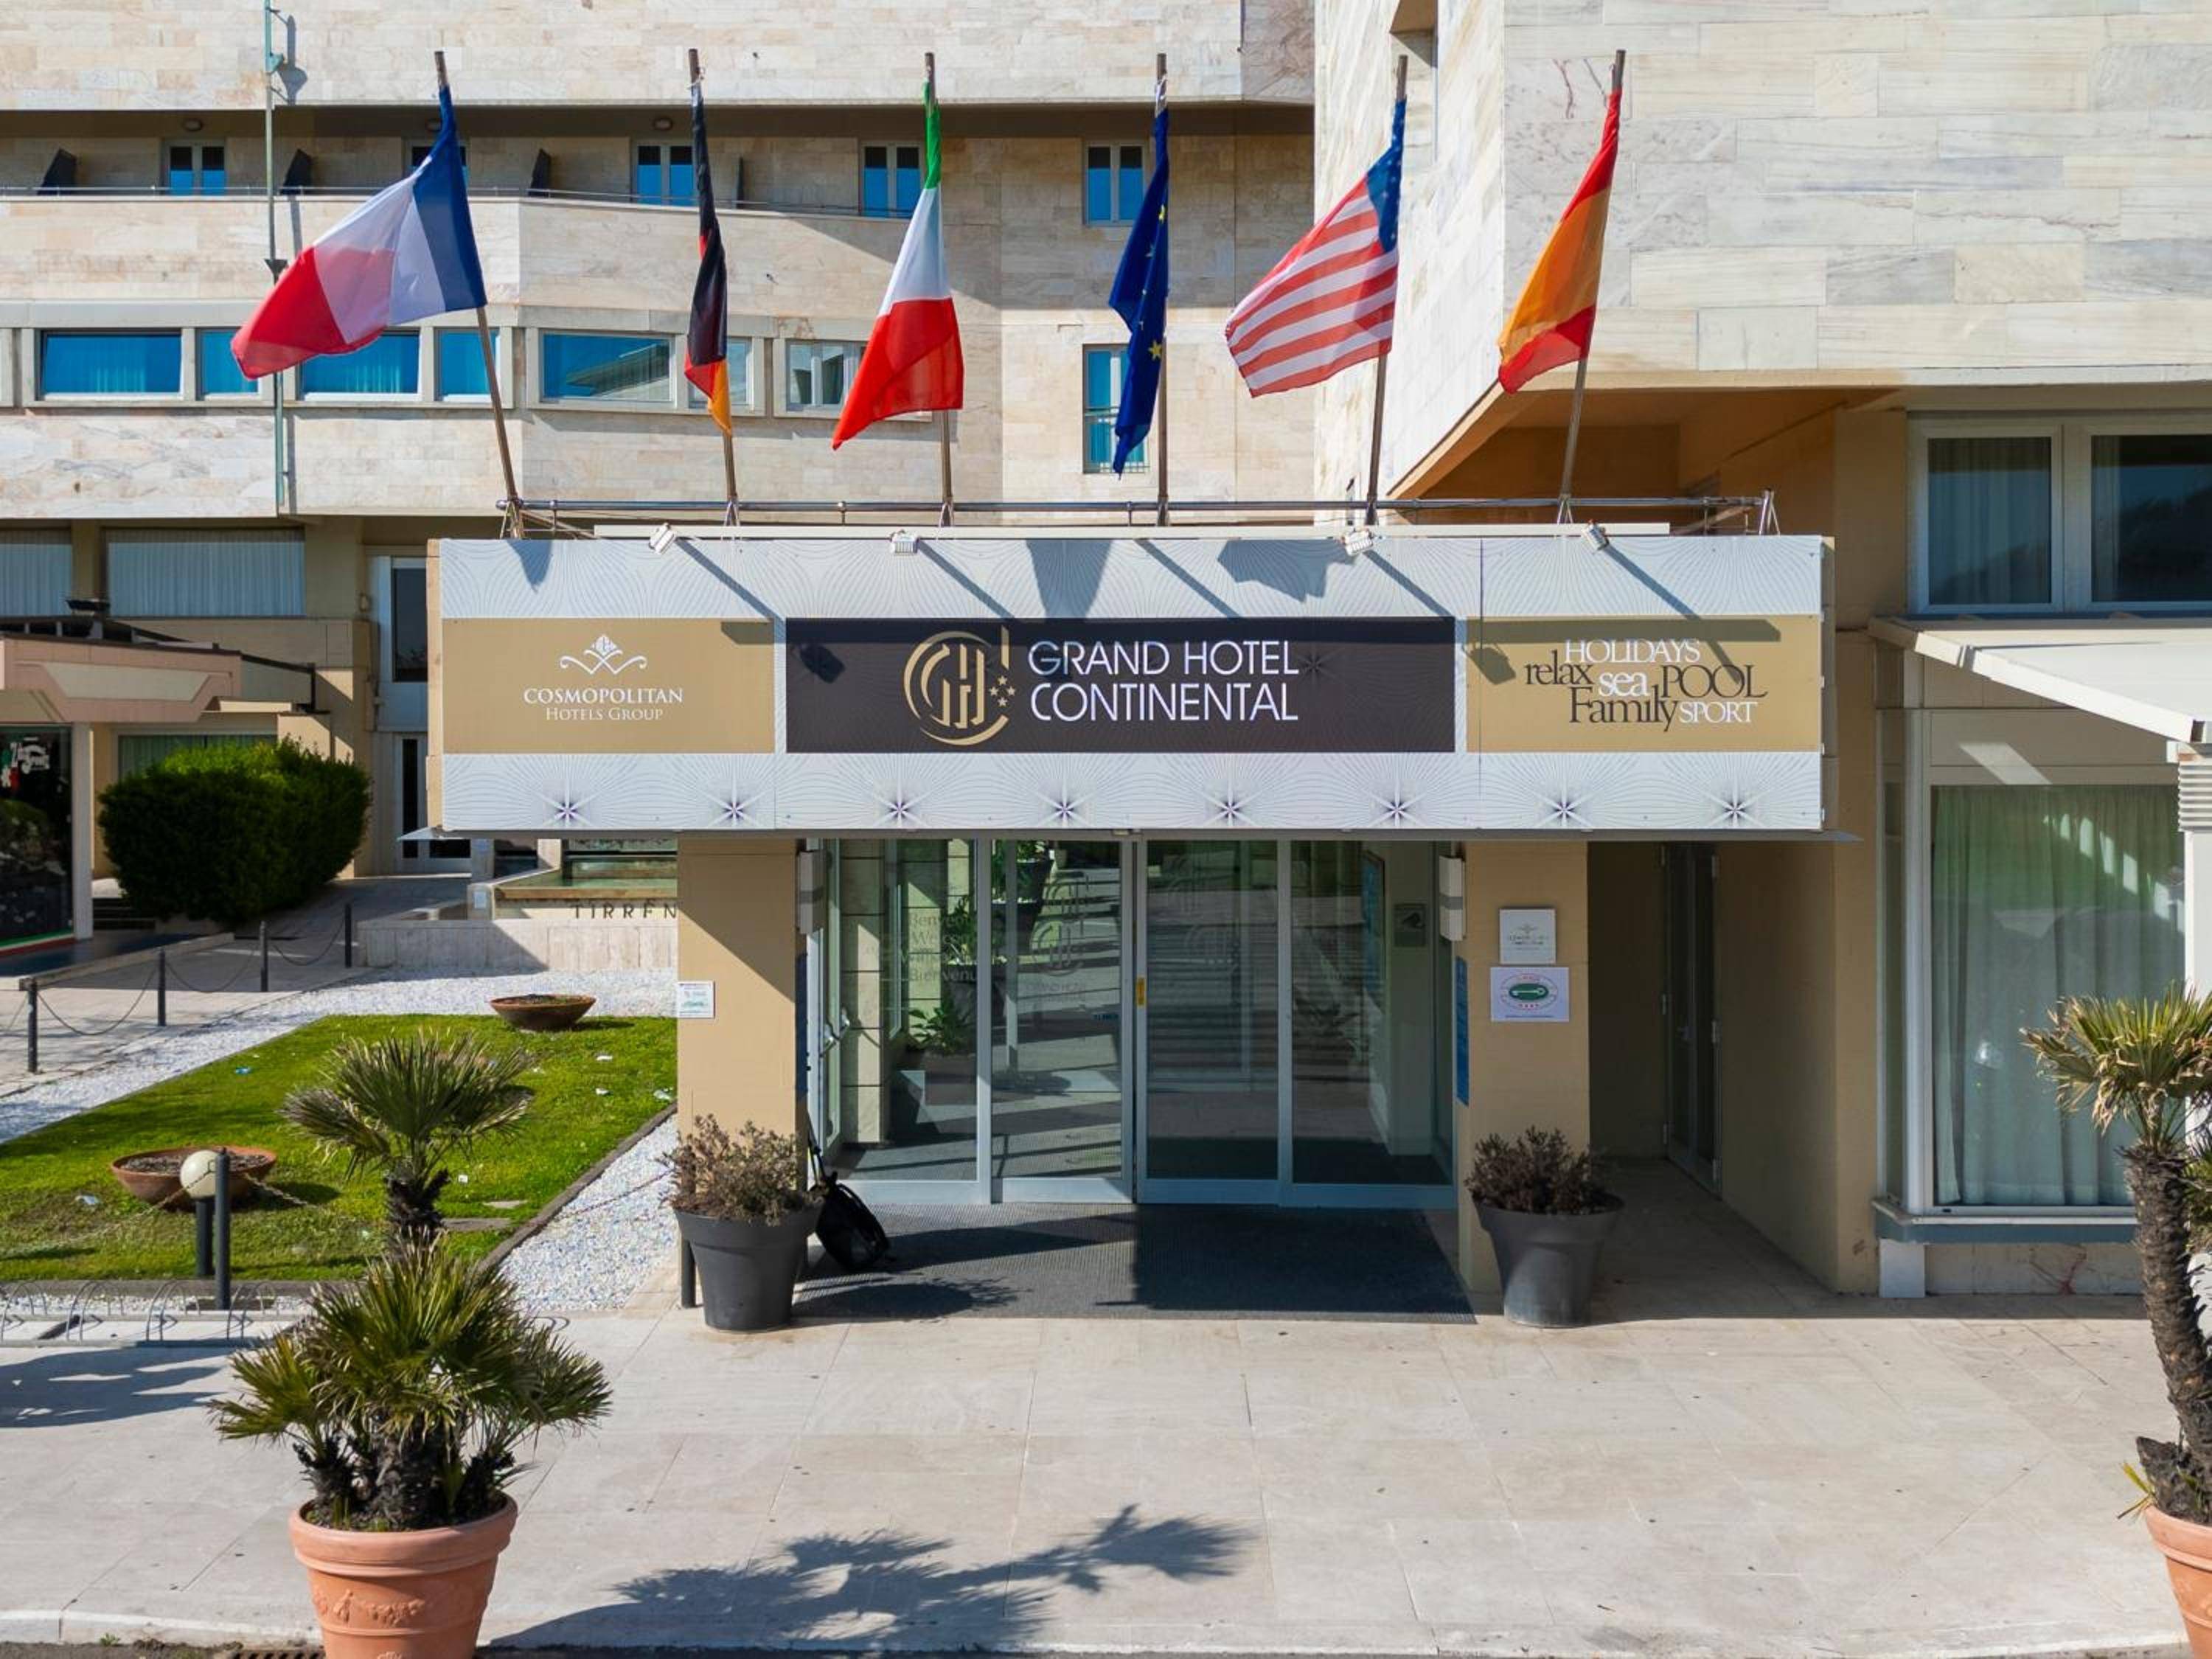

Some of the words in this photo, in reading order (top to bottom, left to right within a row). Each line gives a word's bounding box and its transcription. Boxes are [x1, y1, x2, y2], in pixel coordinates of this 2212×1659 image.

[1027, 640, 1170, 675] GRAND
[1183, 640, 1299, 675] HOTEL
[1564, 639, 1701, 663] HOLIDAYS
[1524, 649, 1596, 686] relax
[1598, 672, 1650, 697] sea
[1659, 664, 1769, 699] POOL
[523, 687, 684, 705] COSMOPOLITAN
[546, 706, 603, 721] HOTELS
[608, 706, 664, 721] GROUP
[1031, 682, 1298, 722] CONTINENTAL
[1568, 684, 1678, 733] Family
[1679, 701, 1759, 723] SPORT
